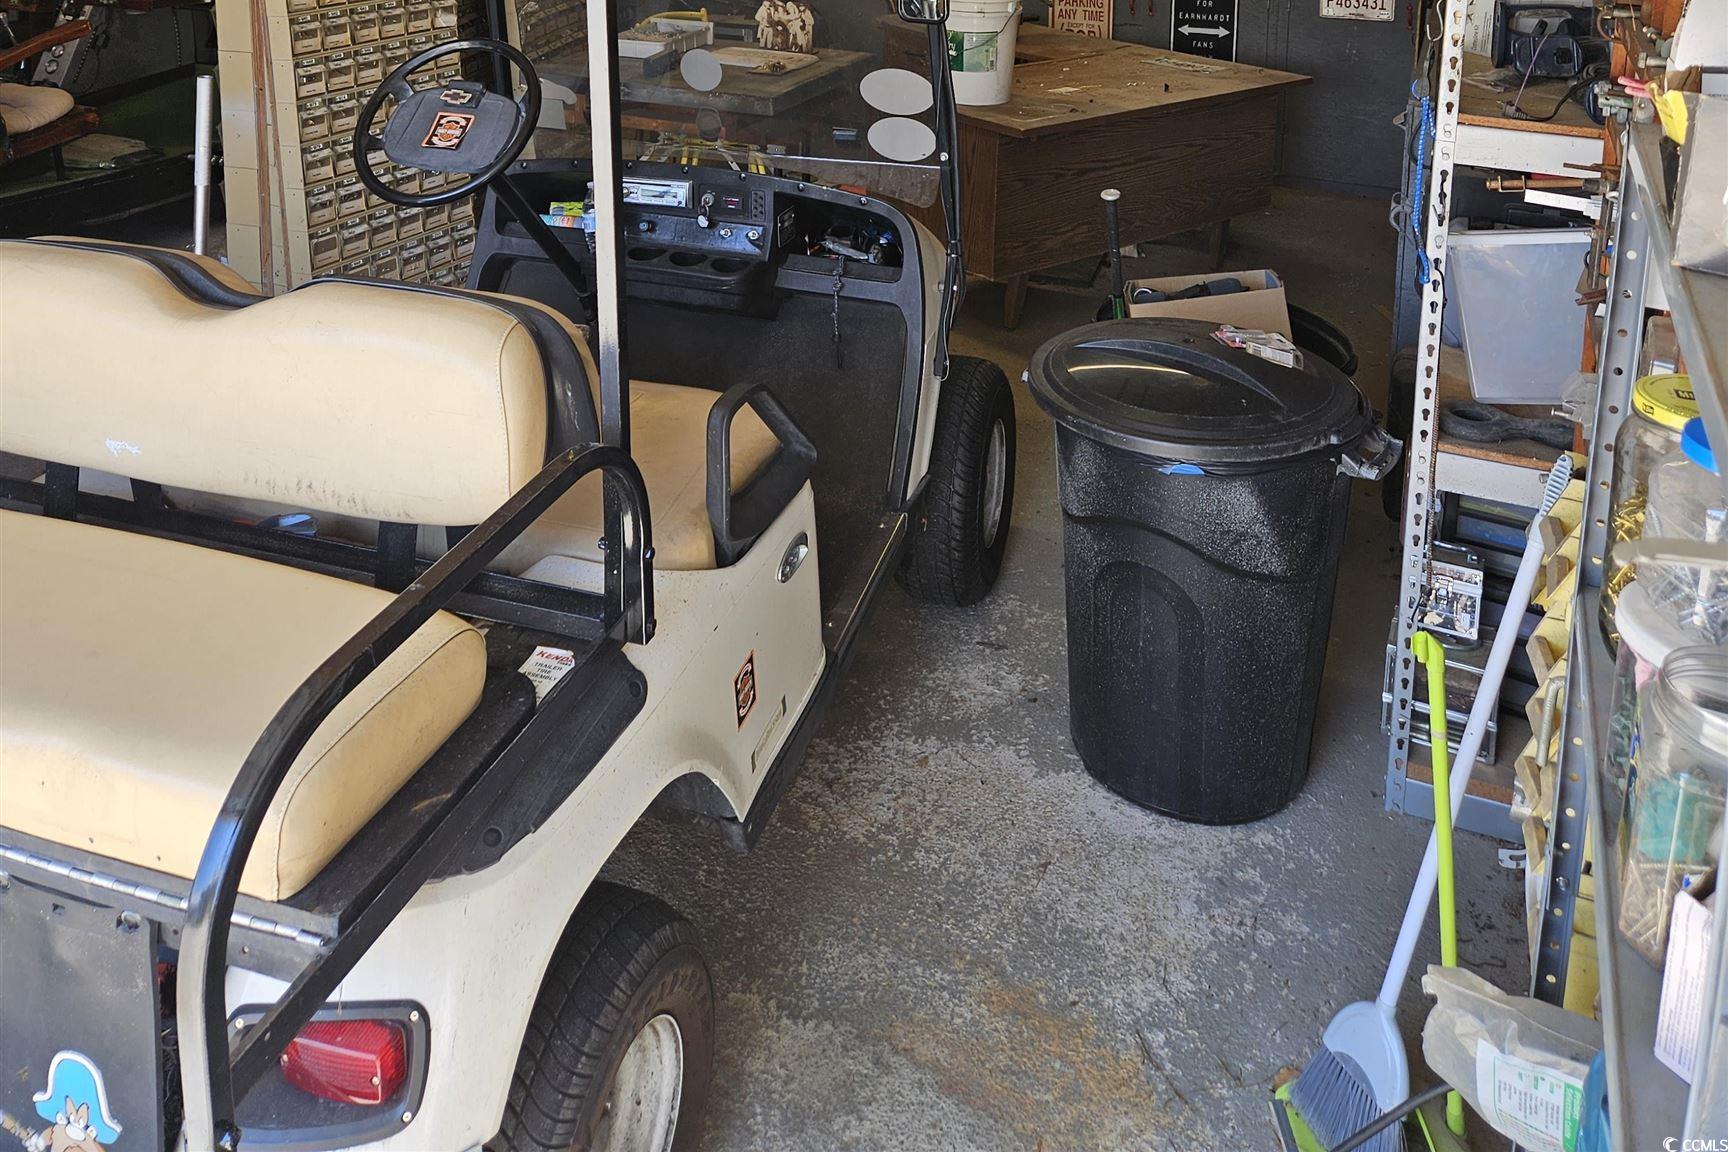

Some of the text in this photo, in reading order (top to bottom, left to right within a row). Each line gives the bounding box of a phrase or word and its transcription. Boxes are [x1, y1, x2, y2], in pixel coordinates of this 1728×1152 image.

[1057, 9, 1104, 22] ANY TIME
[1179, 12, 1230, 22] EARNHARDT
[1067, 21, 1085, 29] EXCEPT
[1192, 40, 1214, 49] FANS
[535, 662, 563, 672] TRAILER
